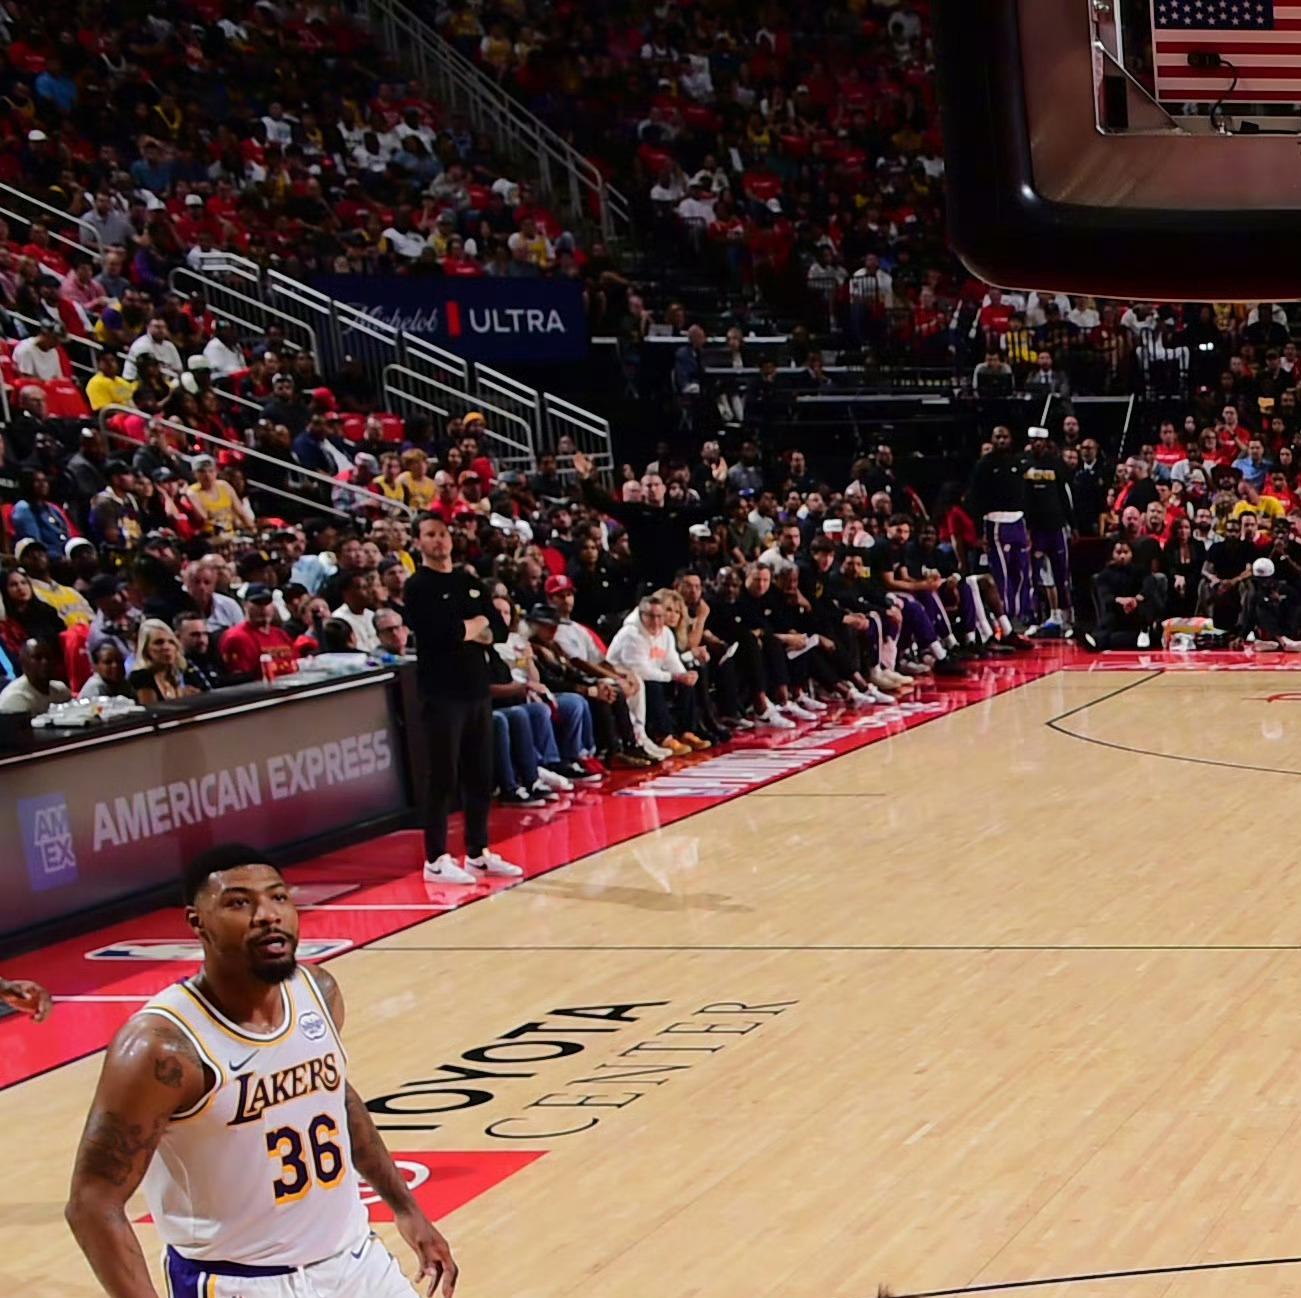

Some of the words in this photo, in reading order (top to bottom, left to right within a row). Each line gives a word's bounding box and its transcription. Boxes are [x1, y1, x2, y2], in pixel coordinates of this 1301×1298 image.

[469, 309, 566, 333] ULTRA
[93, 763, 262, 852] AMERICAN
[267, 729, 392, 800] EXPRESS
[43, 836, 76, 874] EX
[226, 1052, 341, 1127] LAKERS
[485, 1000, 799, 1140] CENTER
[265, 1113, 346, 1206] 36
